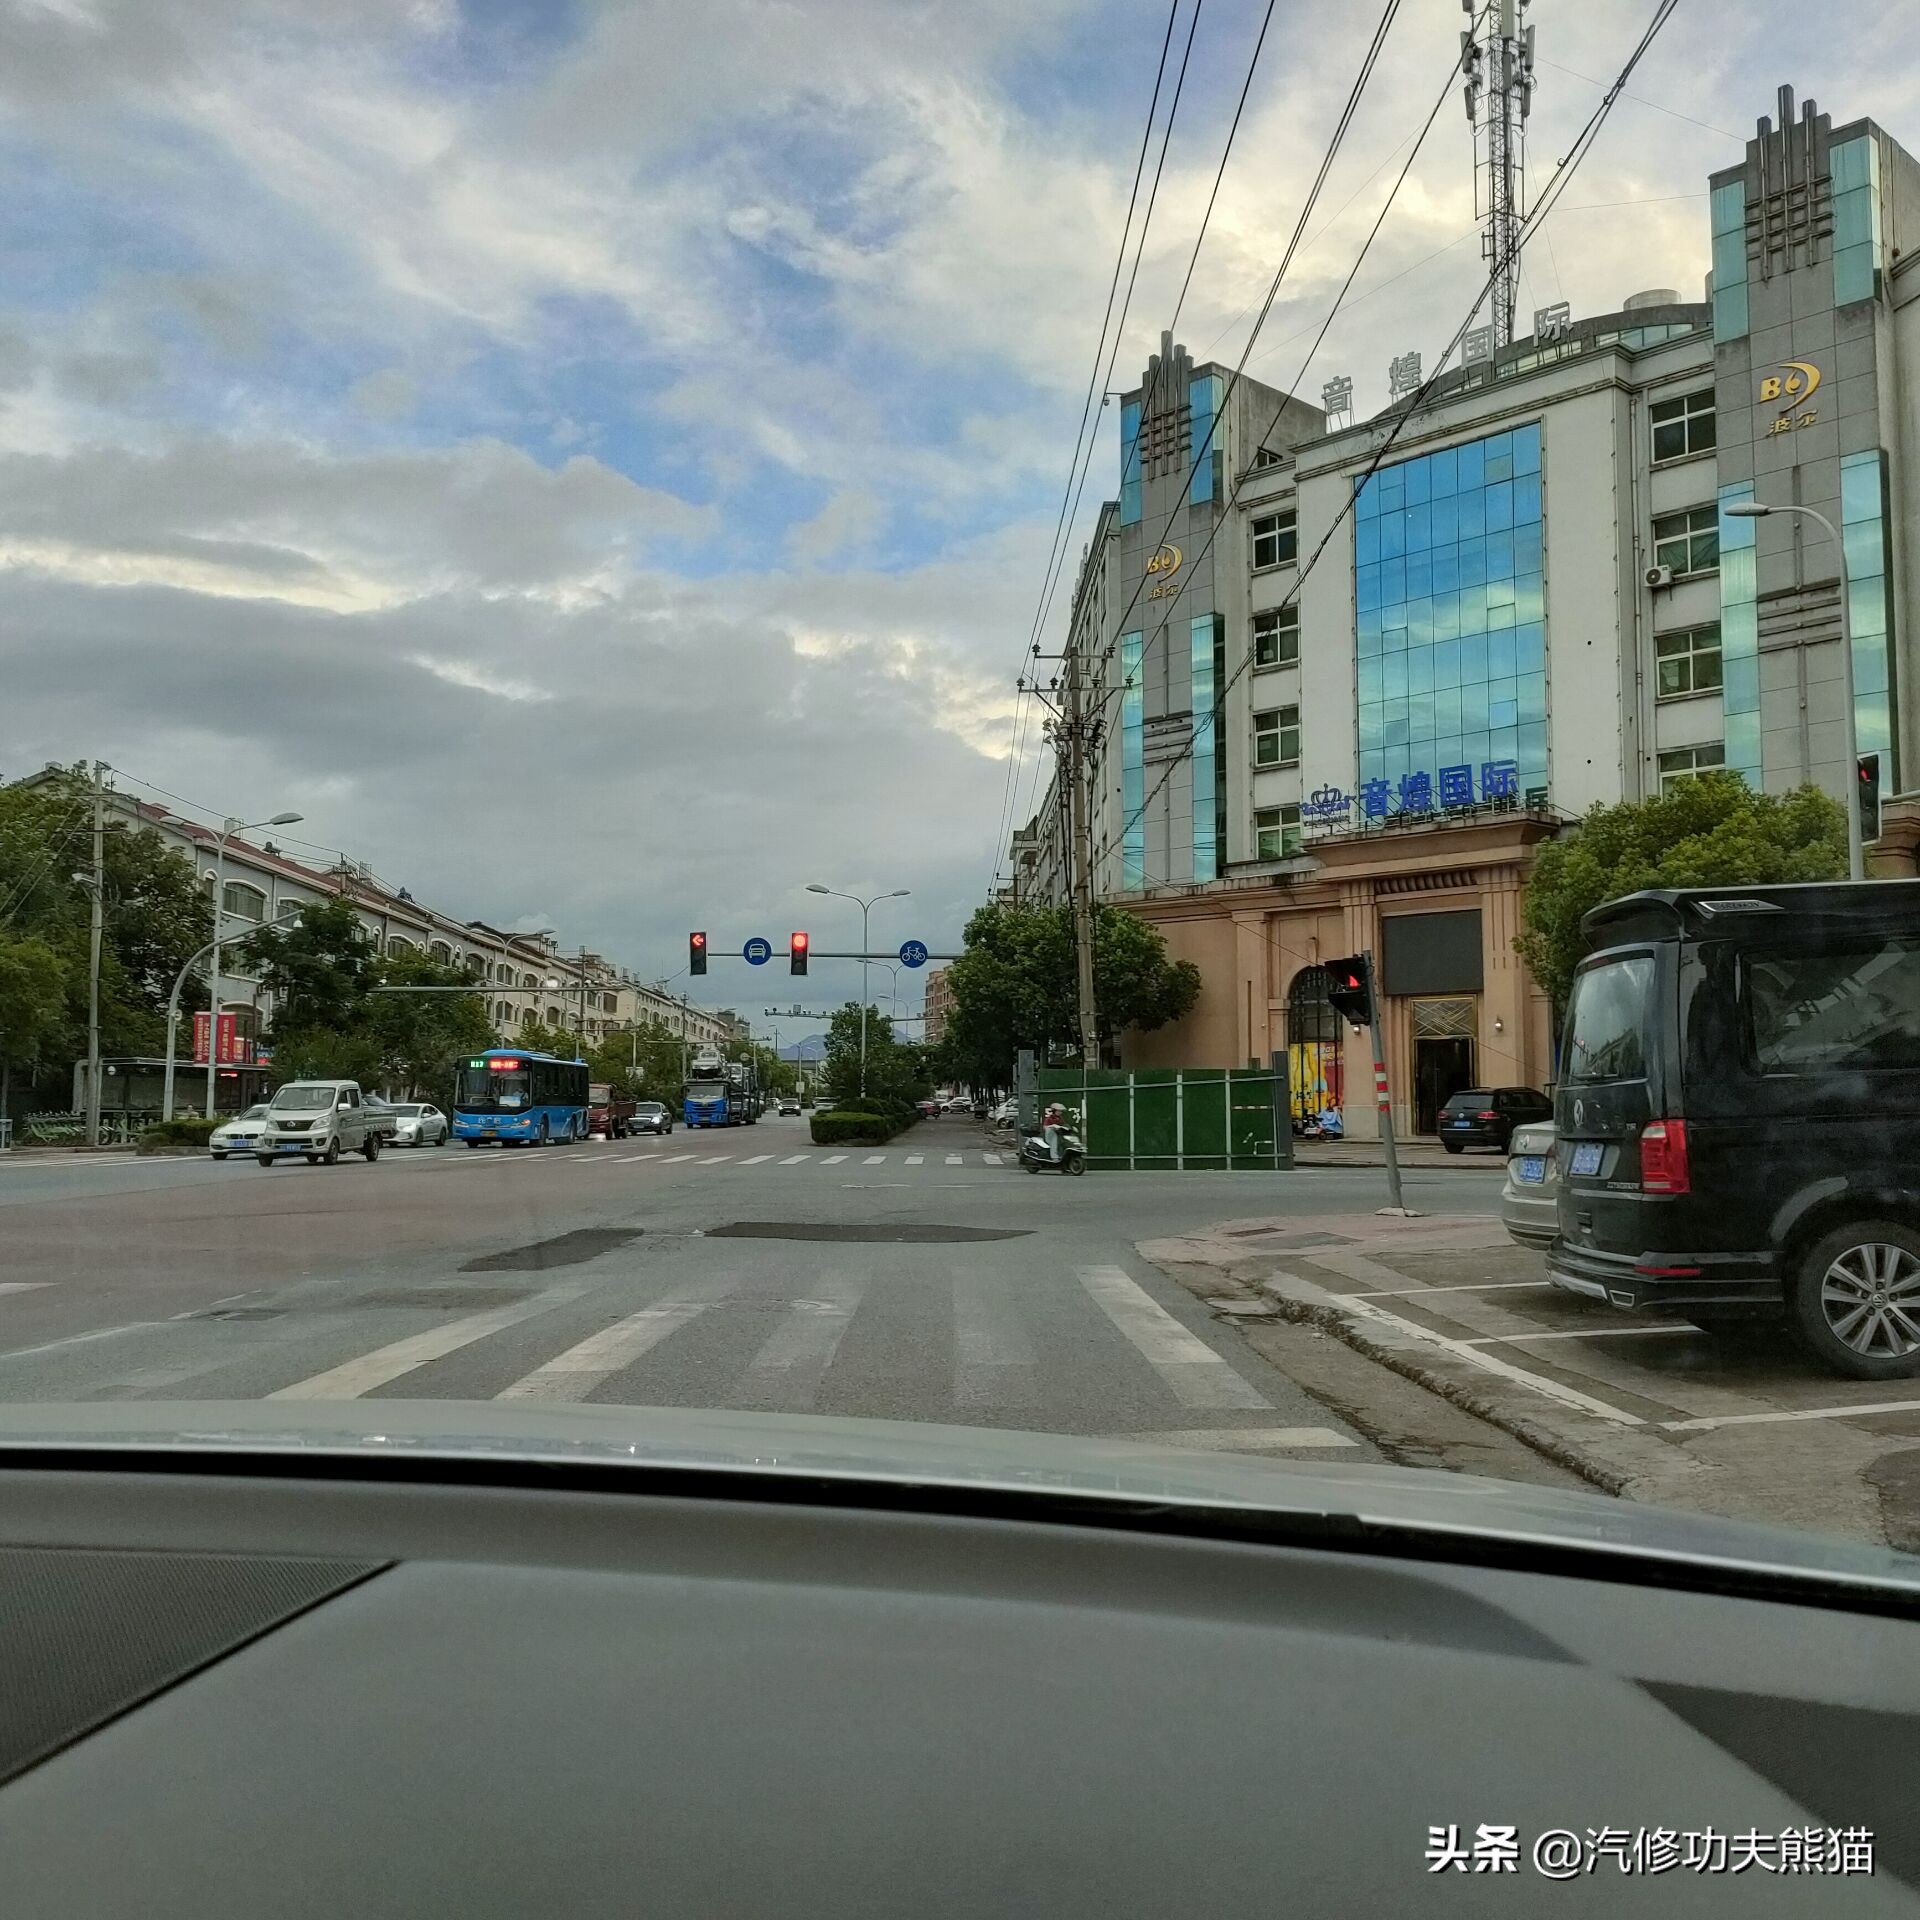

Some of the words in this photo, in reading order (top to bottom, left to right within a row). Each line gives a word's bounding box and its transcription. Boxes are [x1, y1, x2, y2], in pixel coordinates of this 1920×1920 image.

[1321, 301, 1574, 416] 音煌国际
[1360, 759, 1519, 819] 音煌国际
